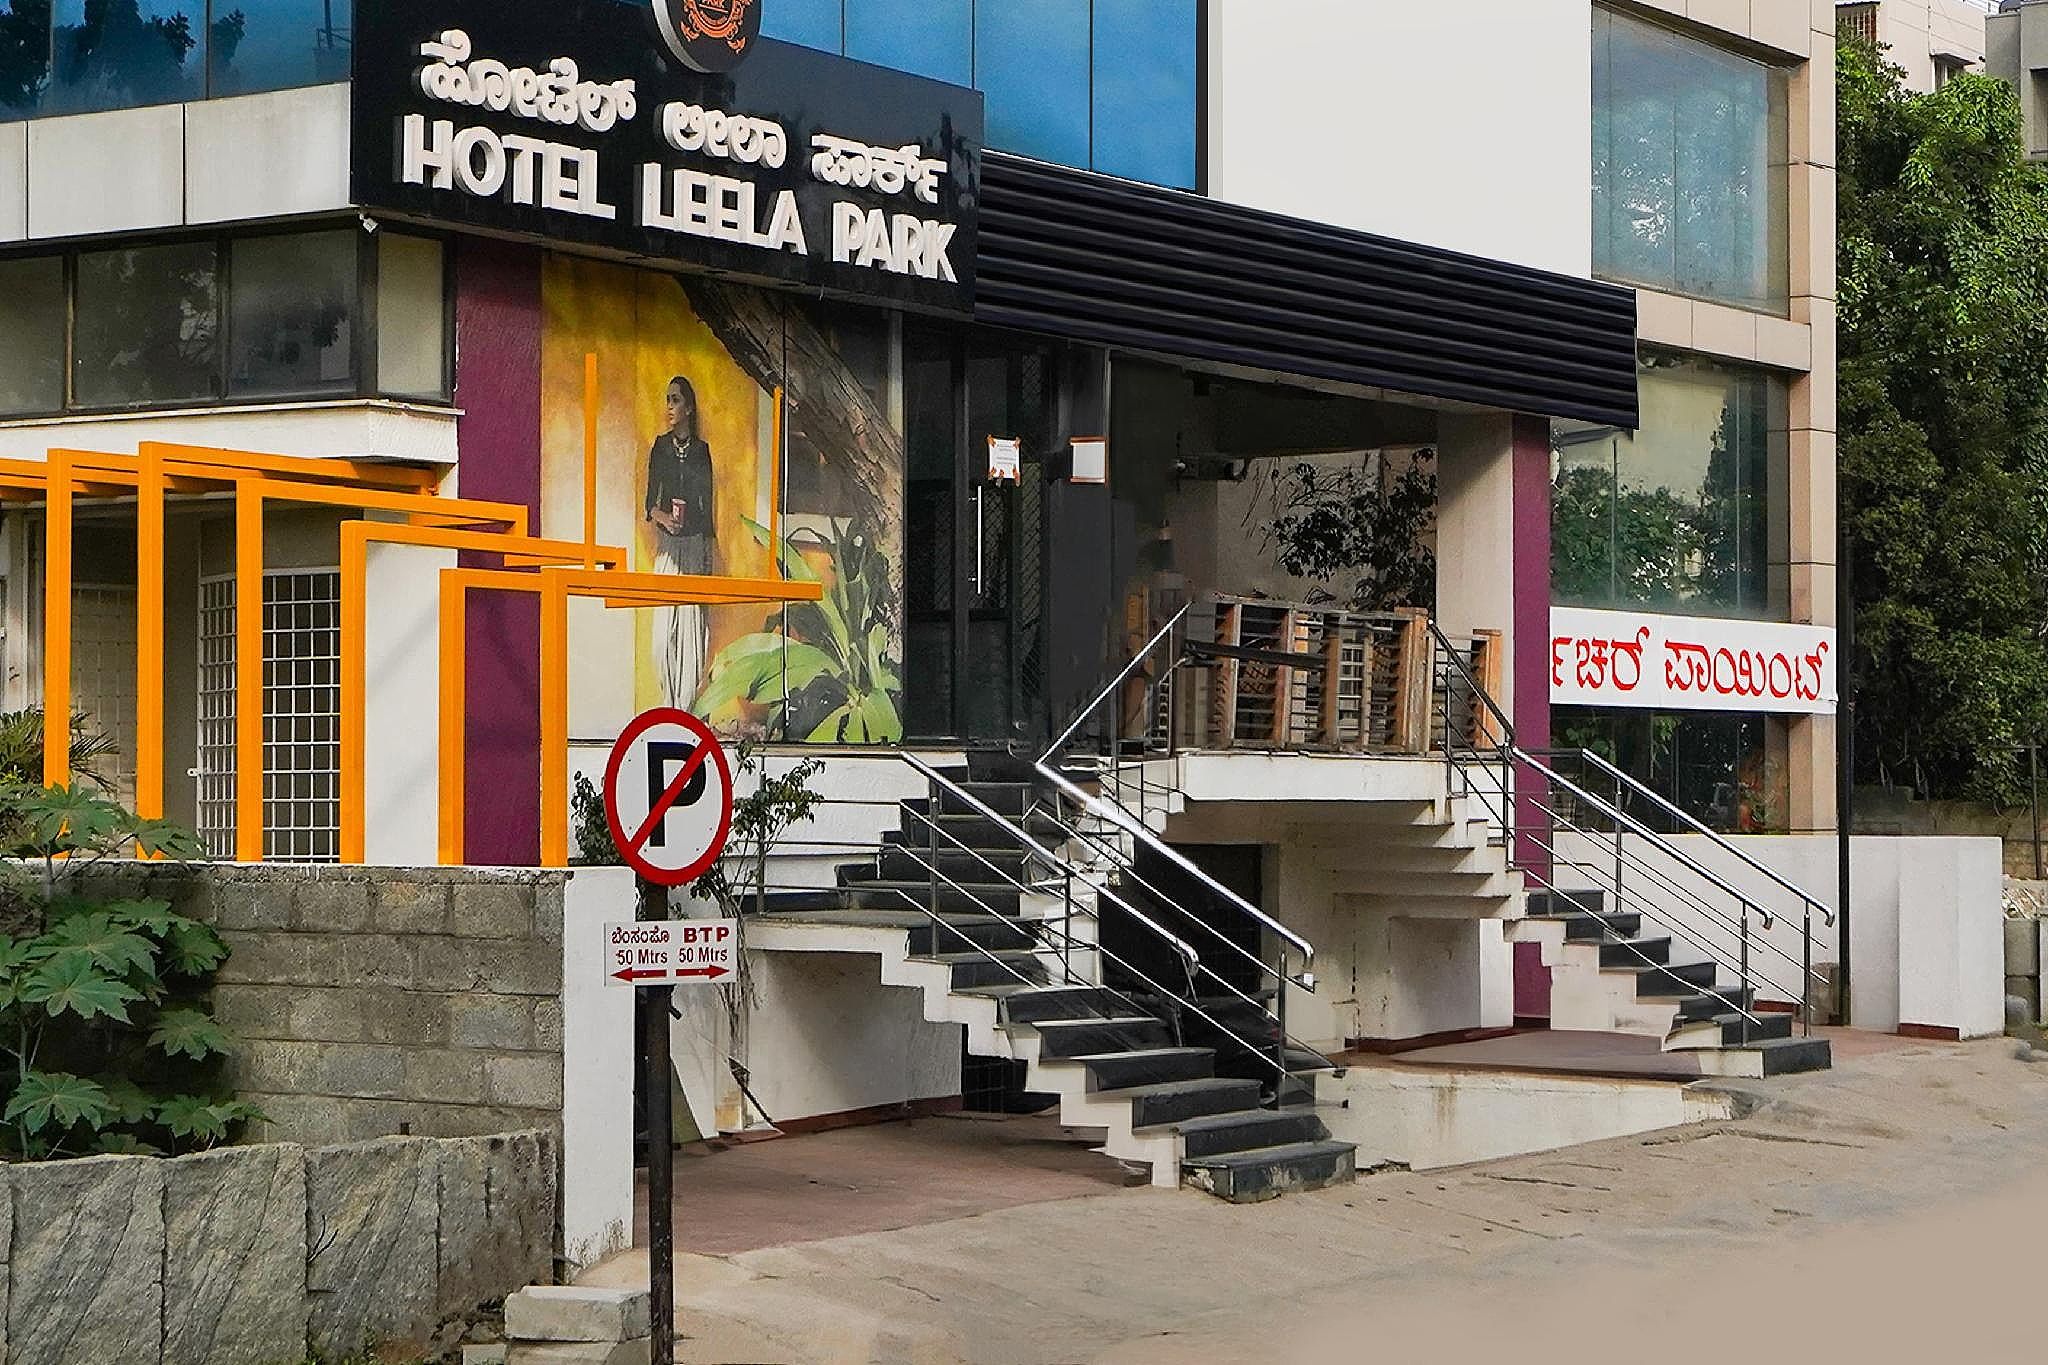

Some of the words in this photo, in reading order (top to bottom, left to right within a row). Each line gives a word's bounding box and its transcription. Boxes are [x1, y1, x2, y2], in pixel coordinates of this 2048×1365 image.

[420, 28, 637, 132] ಹೋಟೆಲ್
[662, 101, 787, 169] ಲೀಲಾ
[403, 114, 616, 220] HOTEL
[642, 162, 808, 255] LEELA
[832, 201, 958, 283] PARK
[617, 949, 633, 965] 50
[638, 948, 668, 964] Mtrs
[679, 948, 694, 963] 50
[698, 947, 728, 962] Mtrs
[683, 926, 730, 943] BTP
